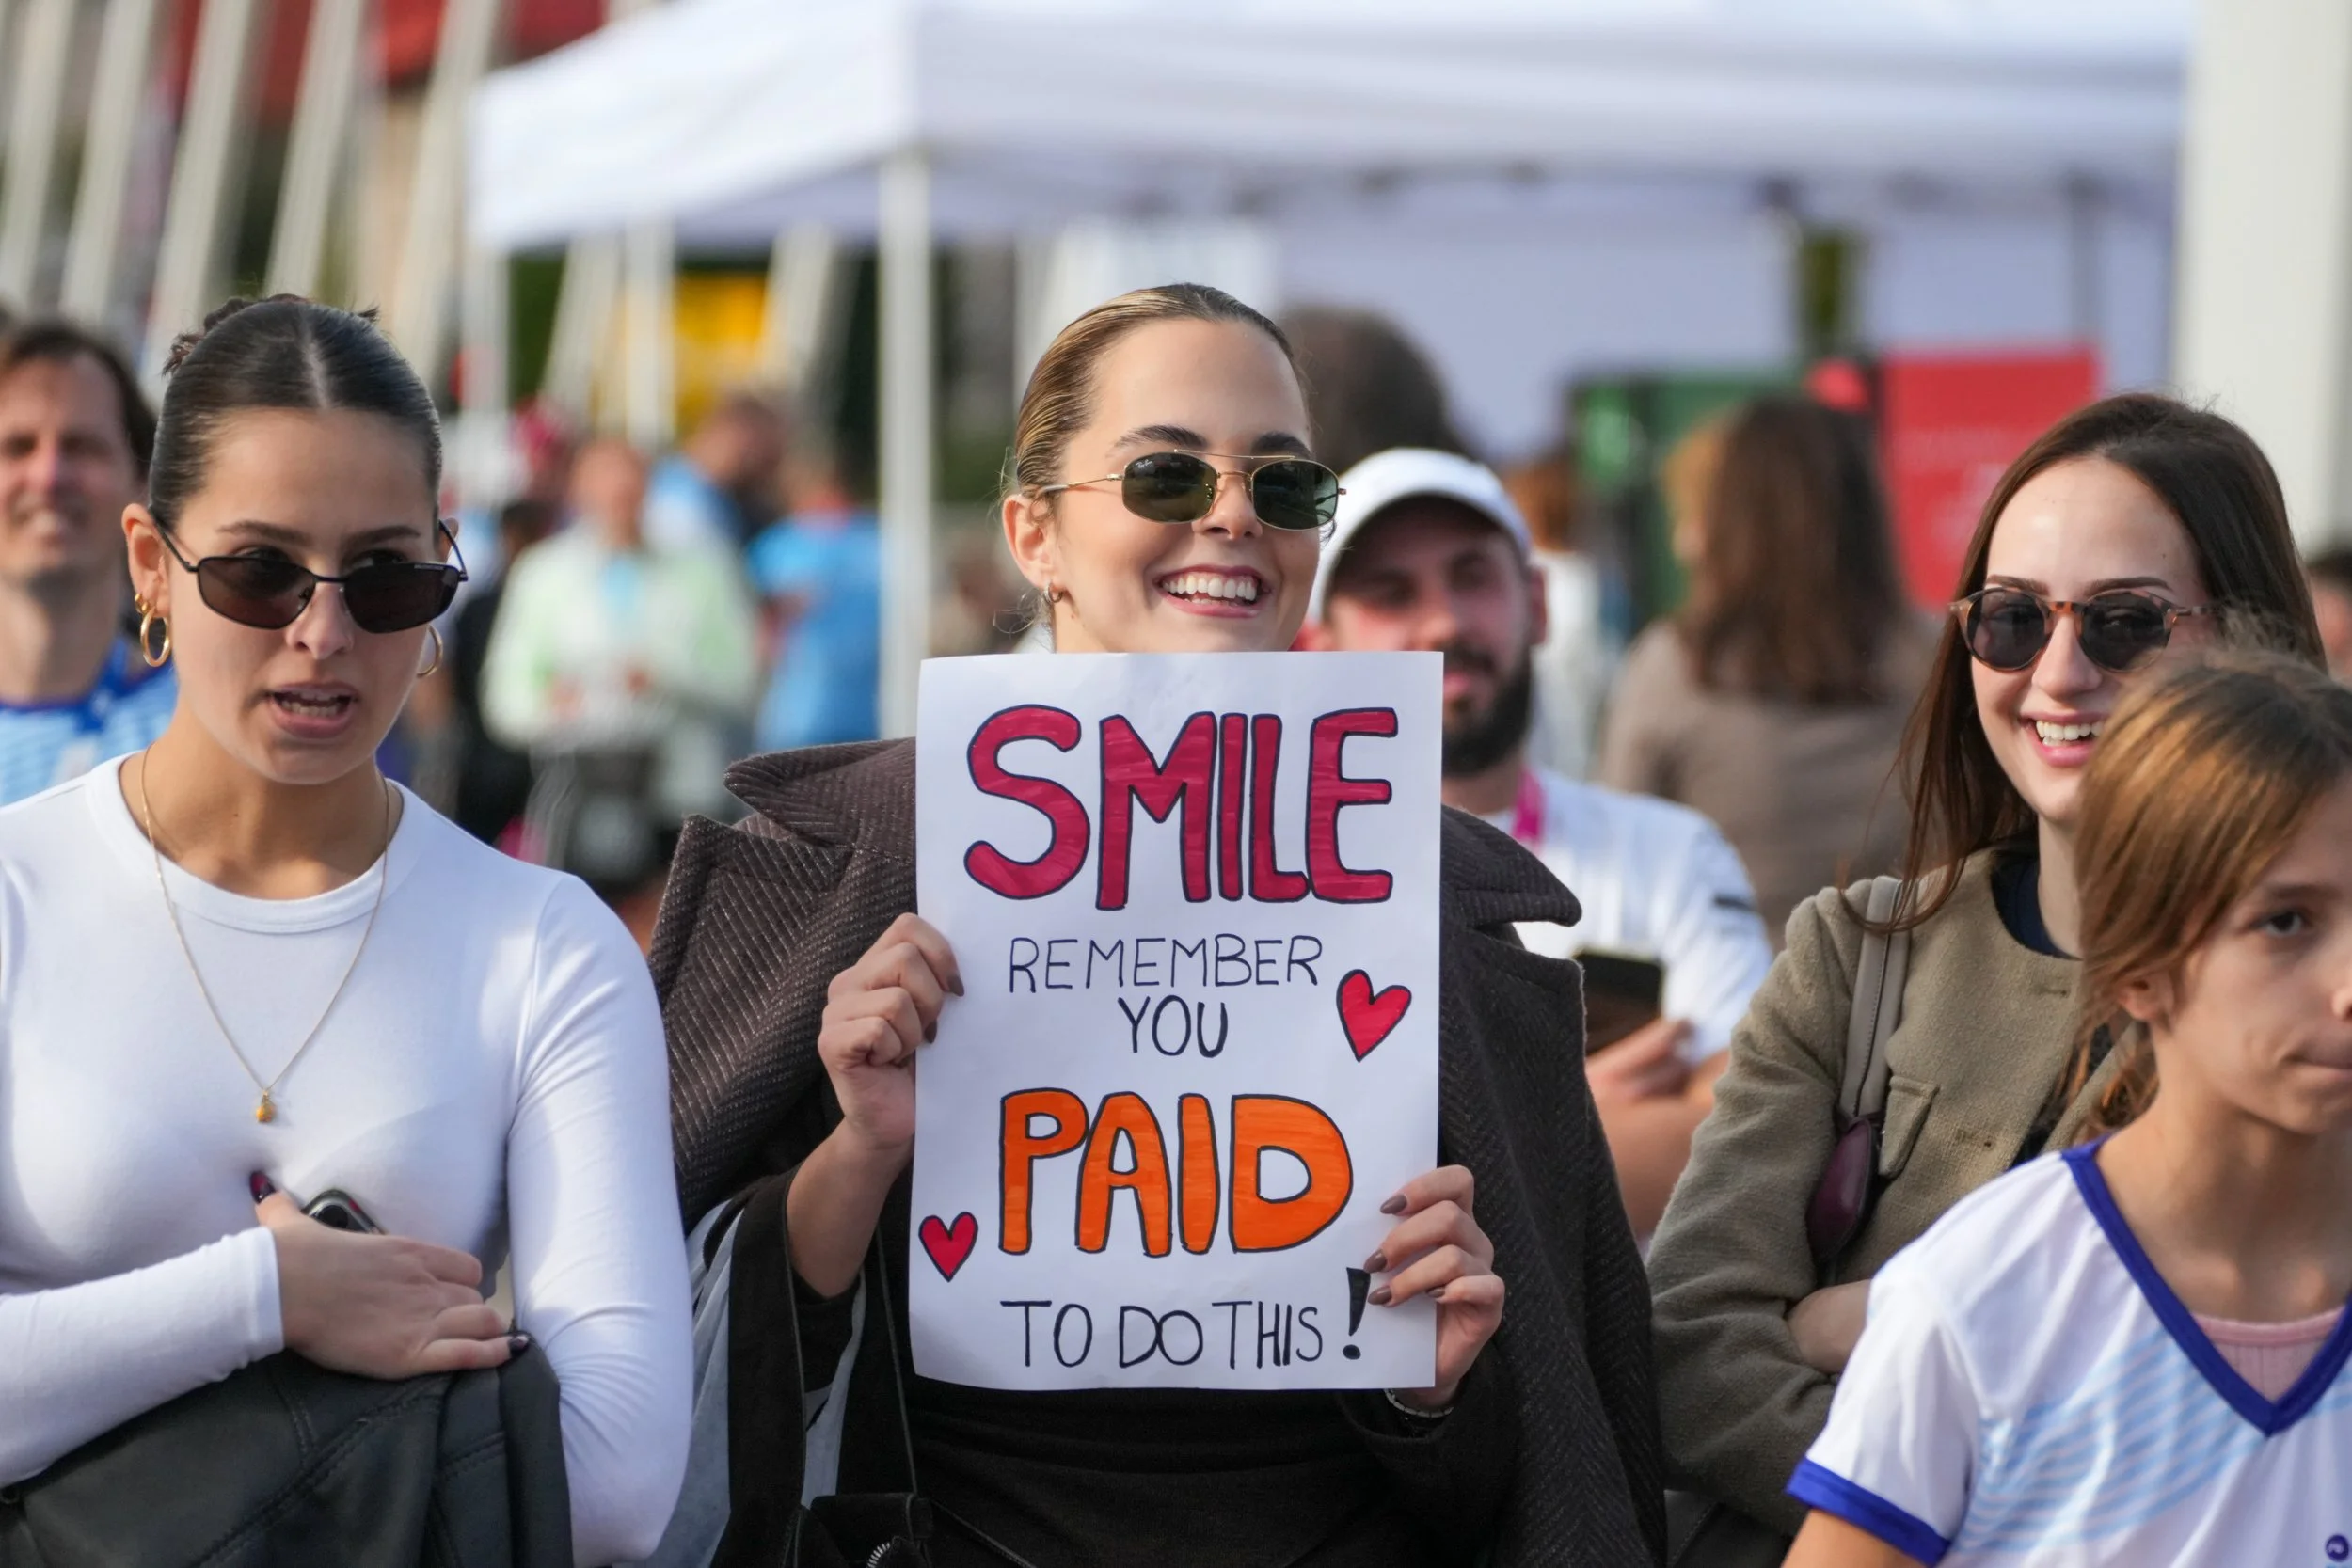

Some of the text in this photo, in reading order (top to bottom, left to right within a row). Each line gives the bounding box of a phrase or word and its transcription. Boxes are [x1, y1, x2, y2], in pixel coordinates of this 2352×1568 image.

[963, 704, 1399, 911] SMILE
[1009, 932, 1323, 994] REMEMBER
[1117, 994, 1229, 1059] YOU
[997, 1087, 1354, 1259] PAID
[999, 1299, 1093, 1369] TO
[1118, 1305, 1204, 1370] DO
